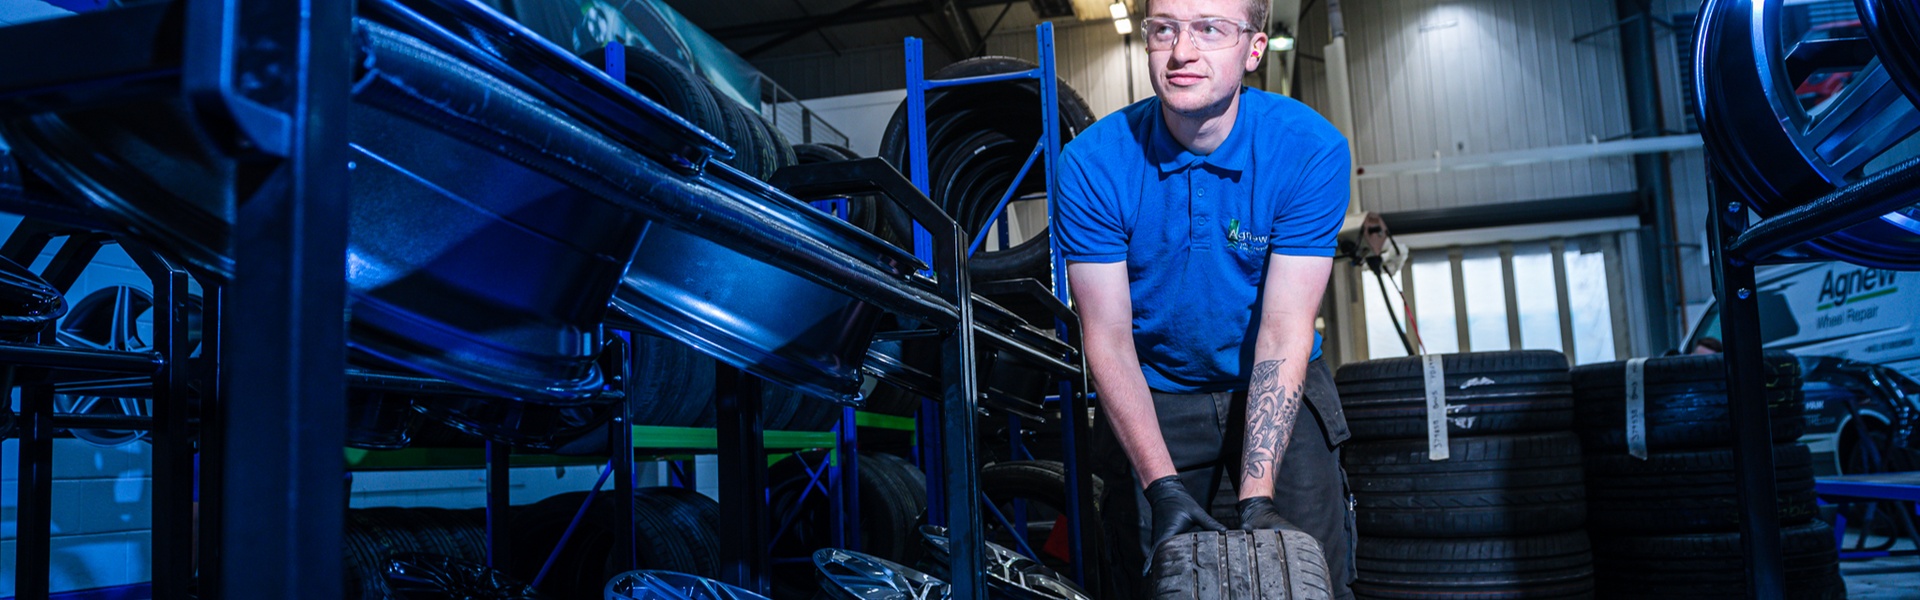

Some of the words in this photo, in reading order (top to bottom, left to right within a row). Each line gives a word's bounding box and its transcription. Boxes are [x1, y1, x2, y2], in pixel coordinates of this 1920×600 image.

[1228, 229, 1268, 243] Agnew
[1818, 268, 1897, 306] Agnew
[1816, 311, 1845, 329] Wheel
[1847, 304, 1879, 323] Repair
